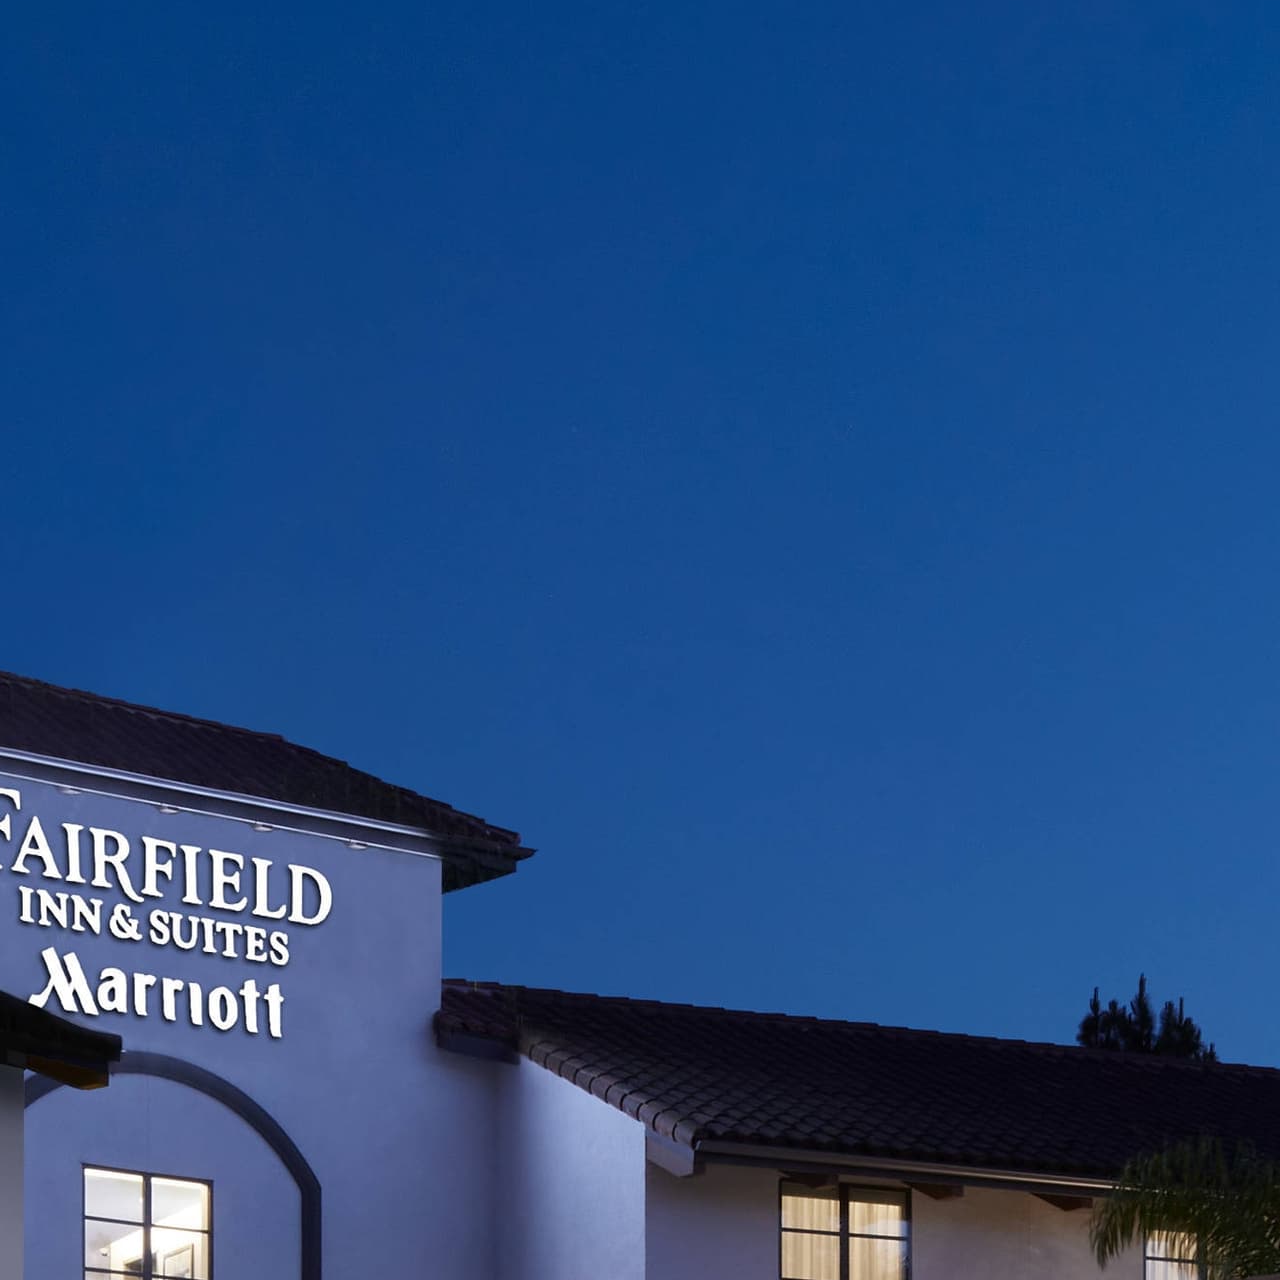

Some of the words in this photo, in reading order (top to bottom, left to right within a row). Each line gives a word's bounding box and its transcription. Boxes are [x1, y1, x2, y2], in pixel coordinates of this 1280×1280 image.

[18, 885, 104, 934] INN
[109, 903, 143, 941] &
[149, 908, 291, 966] SUITES
[28, 946, 285, 1039] Marriott
